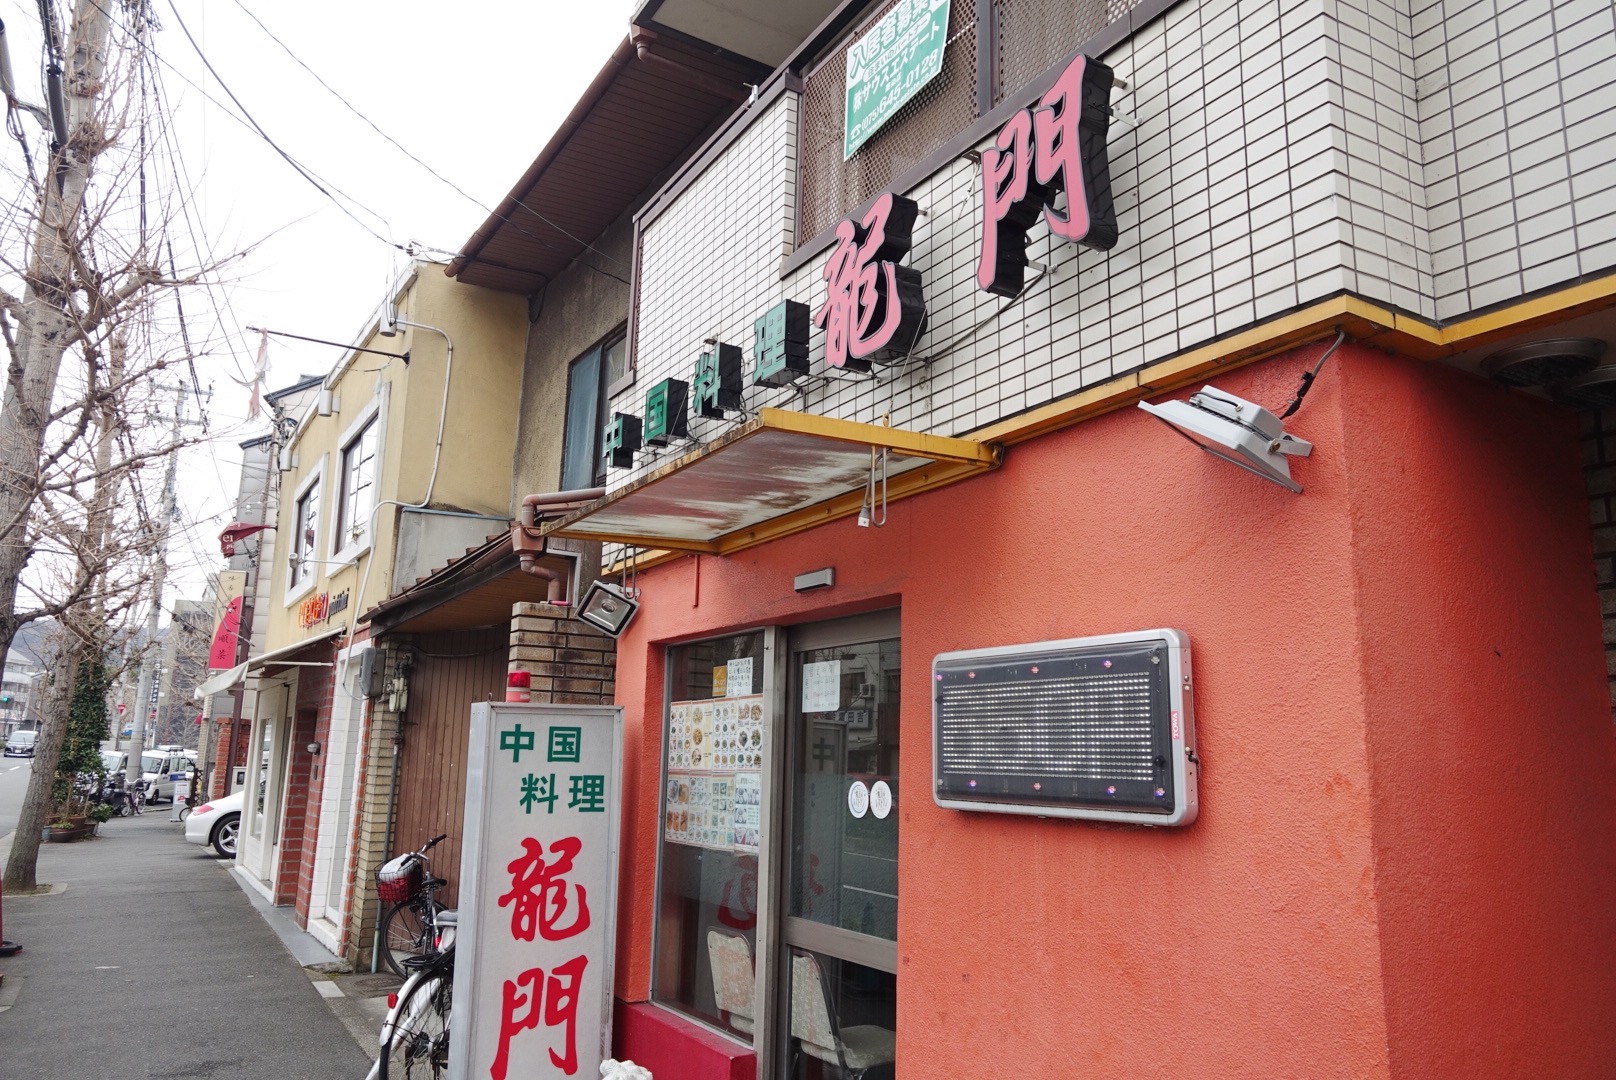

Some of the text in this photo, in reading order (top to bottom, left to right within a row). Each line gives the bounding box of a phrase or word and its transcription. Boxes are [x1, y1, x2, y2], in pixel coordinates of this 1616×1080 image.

[603, 54, 1090, 469] 中国料理 龍門
[500, 724, 582, 764] 中国
[944, 677, 1152, 781] 650円
[519, 773, 605, 814] 料理
[490, 836, 591, 1080] 龍門
